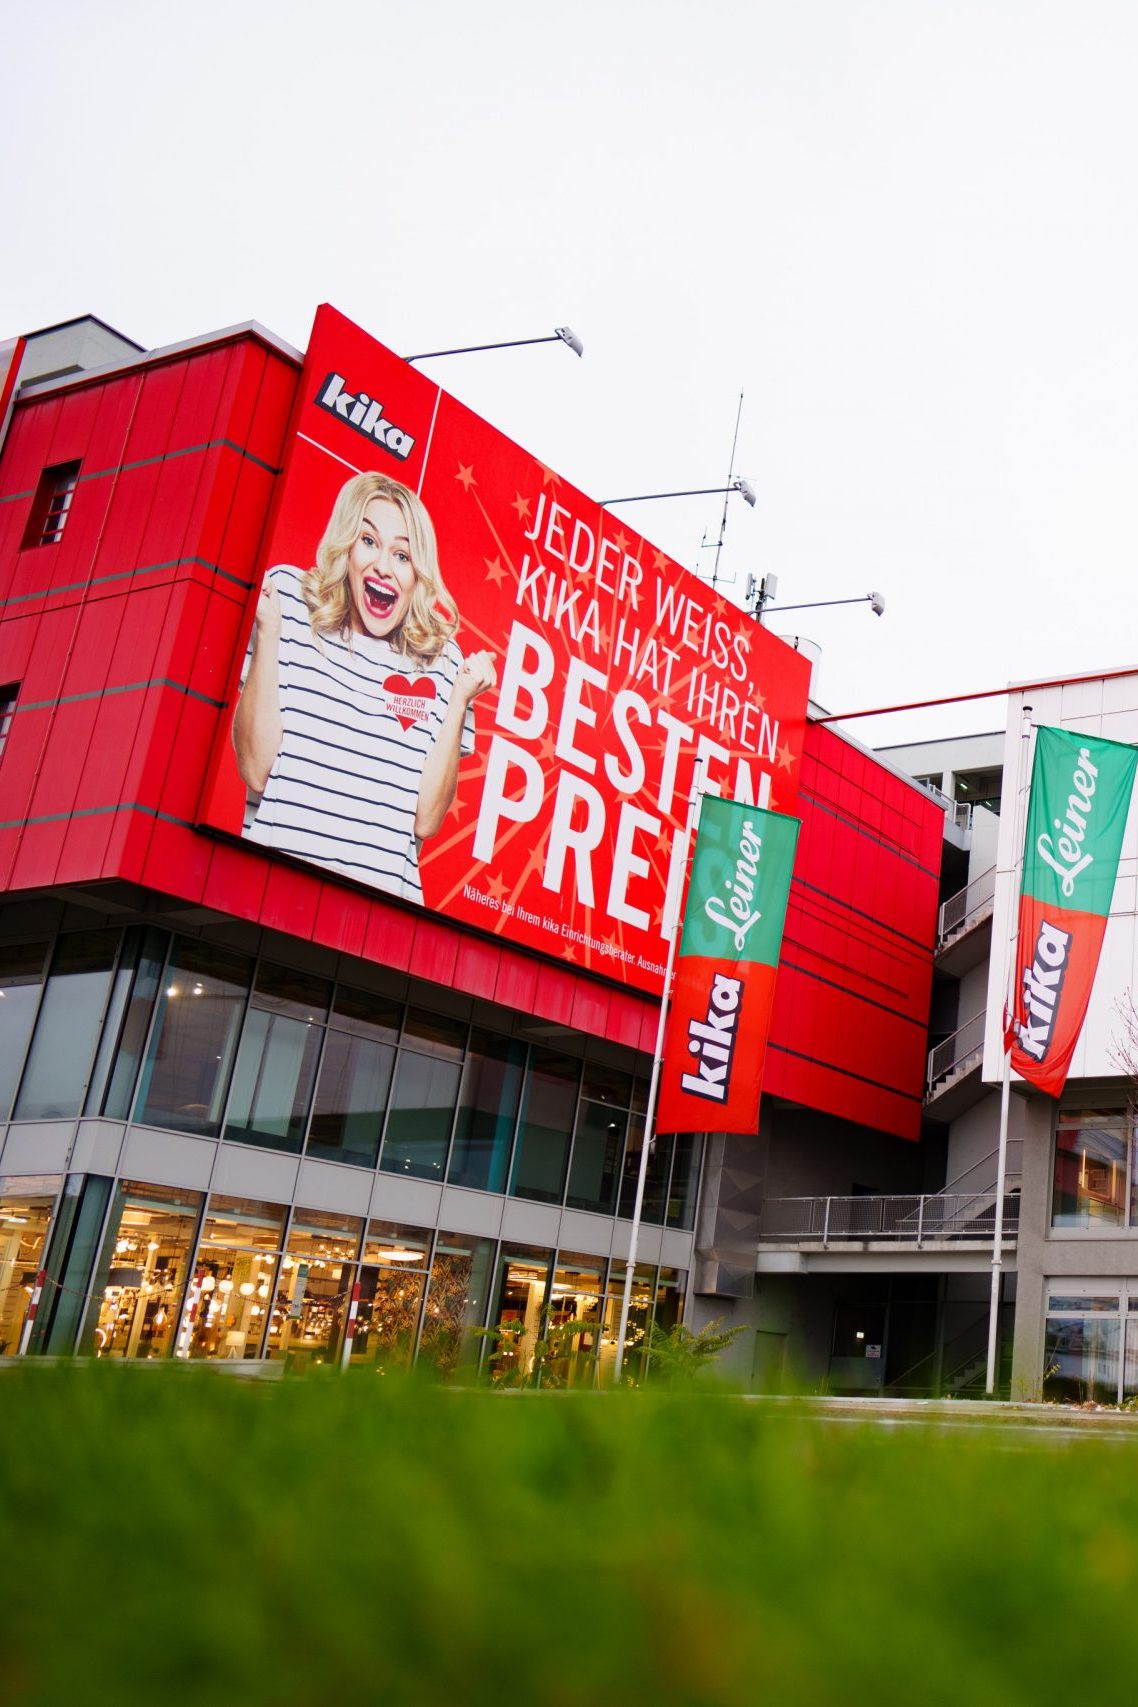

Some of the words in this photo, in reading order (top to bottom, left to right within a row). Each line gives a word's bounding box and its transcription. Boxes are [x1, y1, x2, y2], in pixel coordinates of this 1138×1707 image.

[317, 372, 415, 460] kika
[515, 554, 600, 655] KIKA
[613, 616, 681, 692] HAT
[687, 666, 780, 763] IHREN
[524, 492, 644, 611] JEDER
[655, 576, 756, 697] WEISS,
[386, 703, 430, 722] WILLKOMMEN
[393, 696, 426, 709] HERZLICH
[704, 821, 763, 951] Leiner
[1037, 747, 1099, 898] Leiner
[463, 884, 499, 911] Näheres
[501, 901, 515, 917] bei
[517, 904, 540, 927] Ihrem
[542, 916, 559, 935] kika
[561, 924, 635, 966] Einrichtungsberater.
[681, 972, 743, 1102] kika
[1017, 920, 1071, 1062] kika
